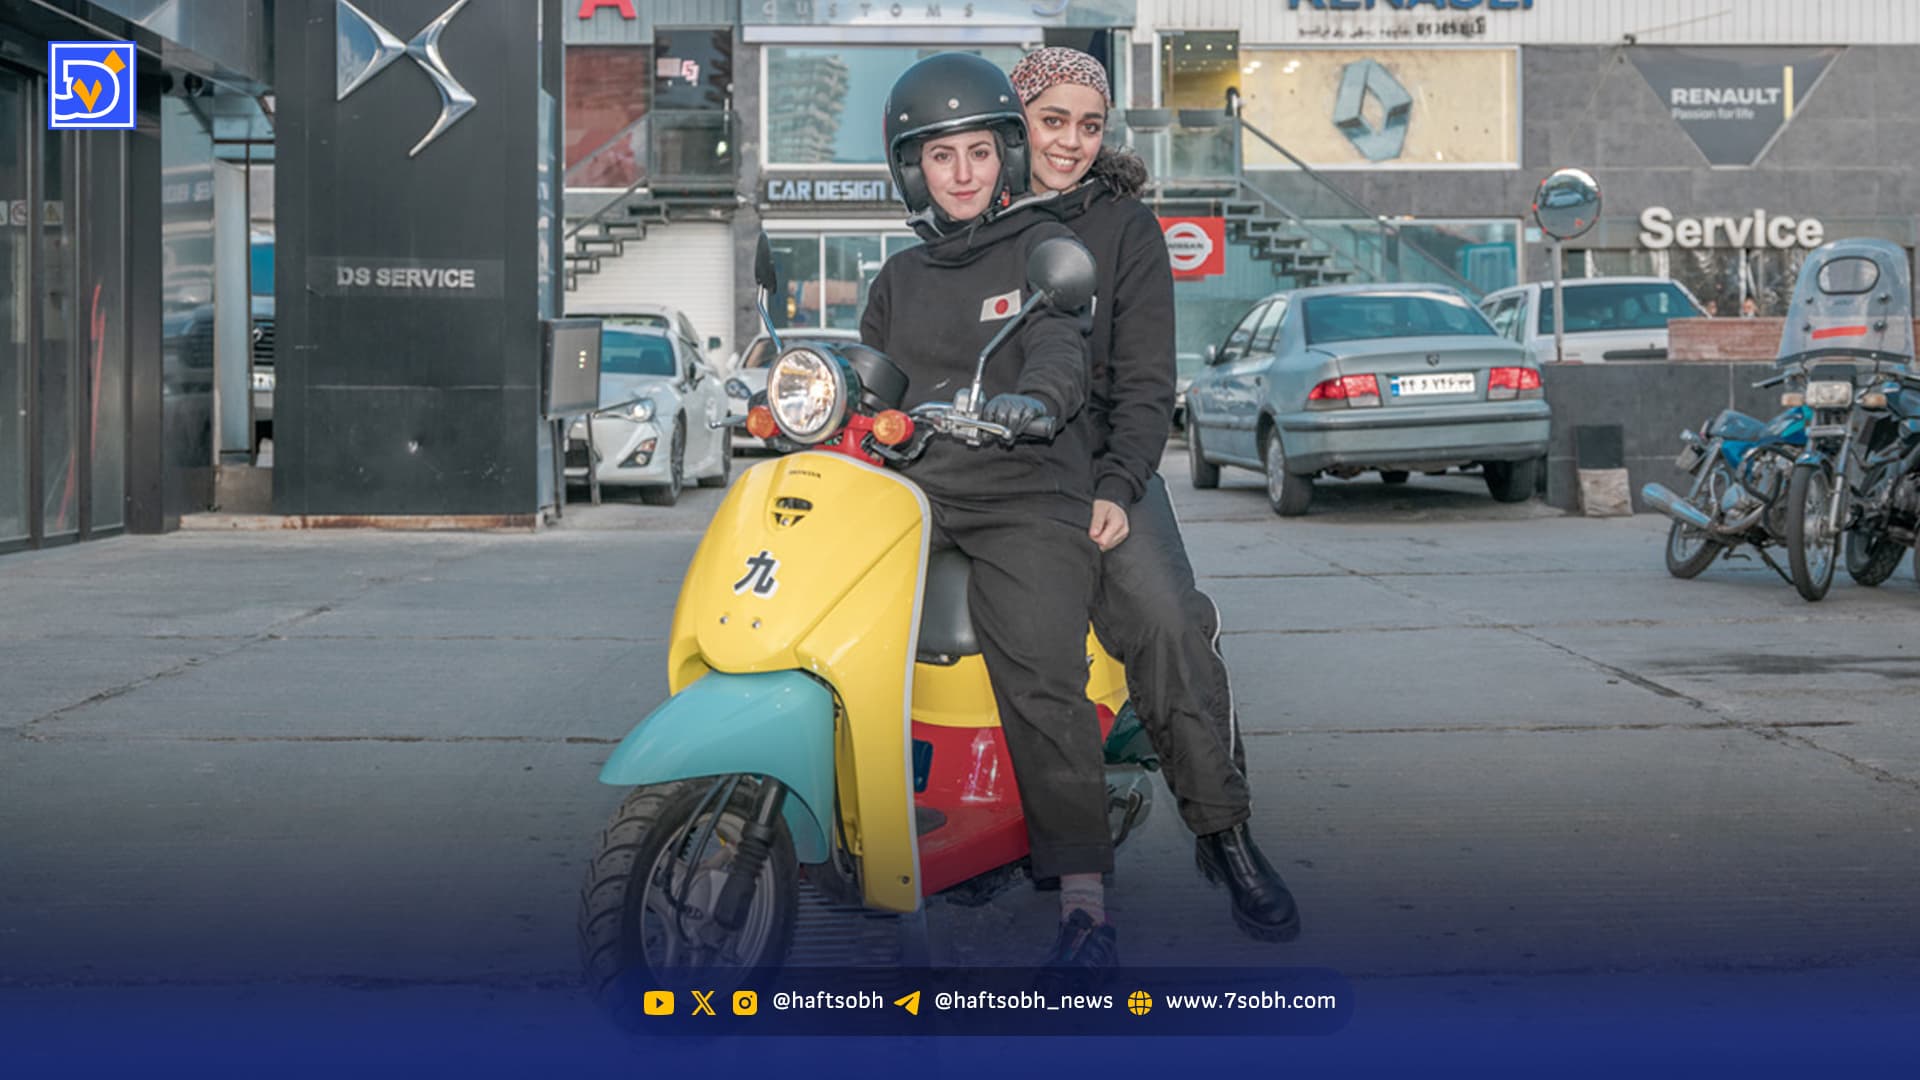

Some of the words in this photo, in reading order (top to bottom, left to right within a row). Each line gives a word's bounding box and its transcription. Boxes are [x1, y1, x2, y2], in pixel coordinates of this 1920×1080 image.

[1671, 87, 1781, 105] RENAULT
[1671, 107, 1716, 120] Passion
[1717, 107, 1735, 120] for
[1735, 107, 1756, 120] life
[767, 179, 812, 201] CAR
[814, 179, 886, 201] DESIGN
[1639, 206, 1825, 250] Service
[337, 266, 371, 286] DS
[375, 267, 476, 289] SERVICE
[733, 550, 778, 597] 九
